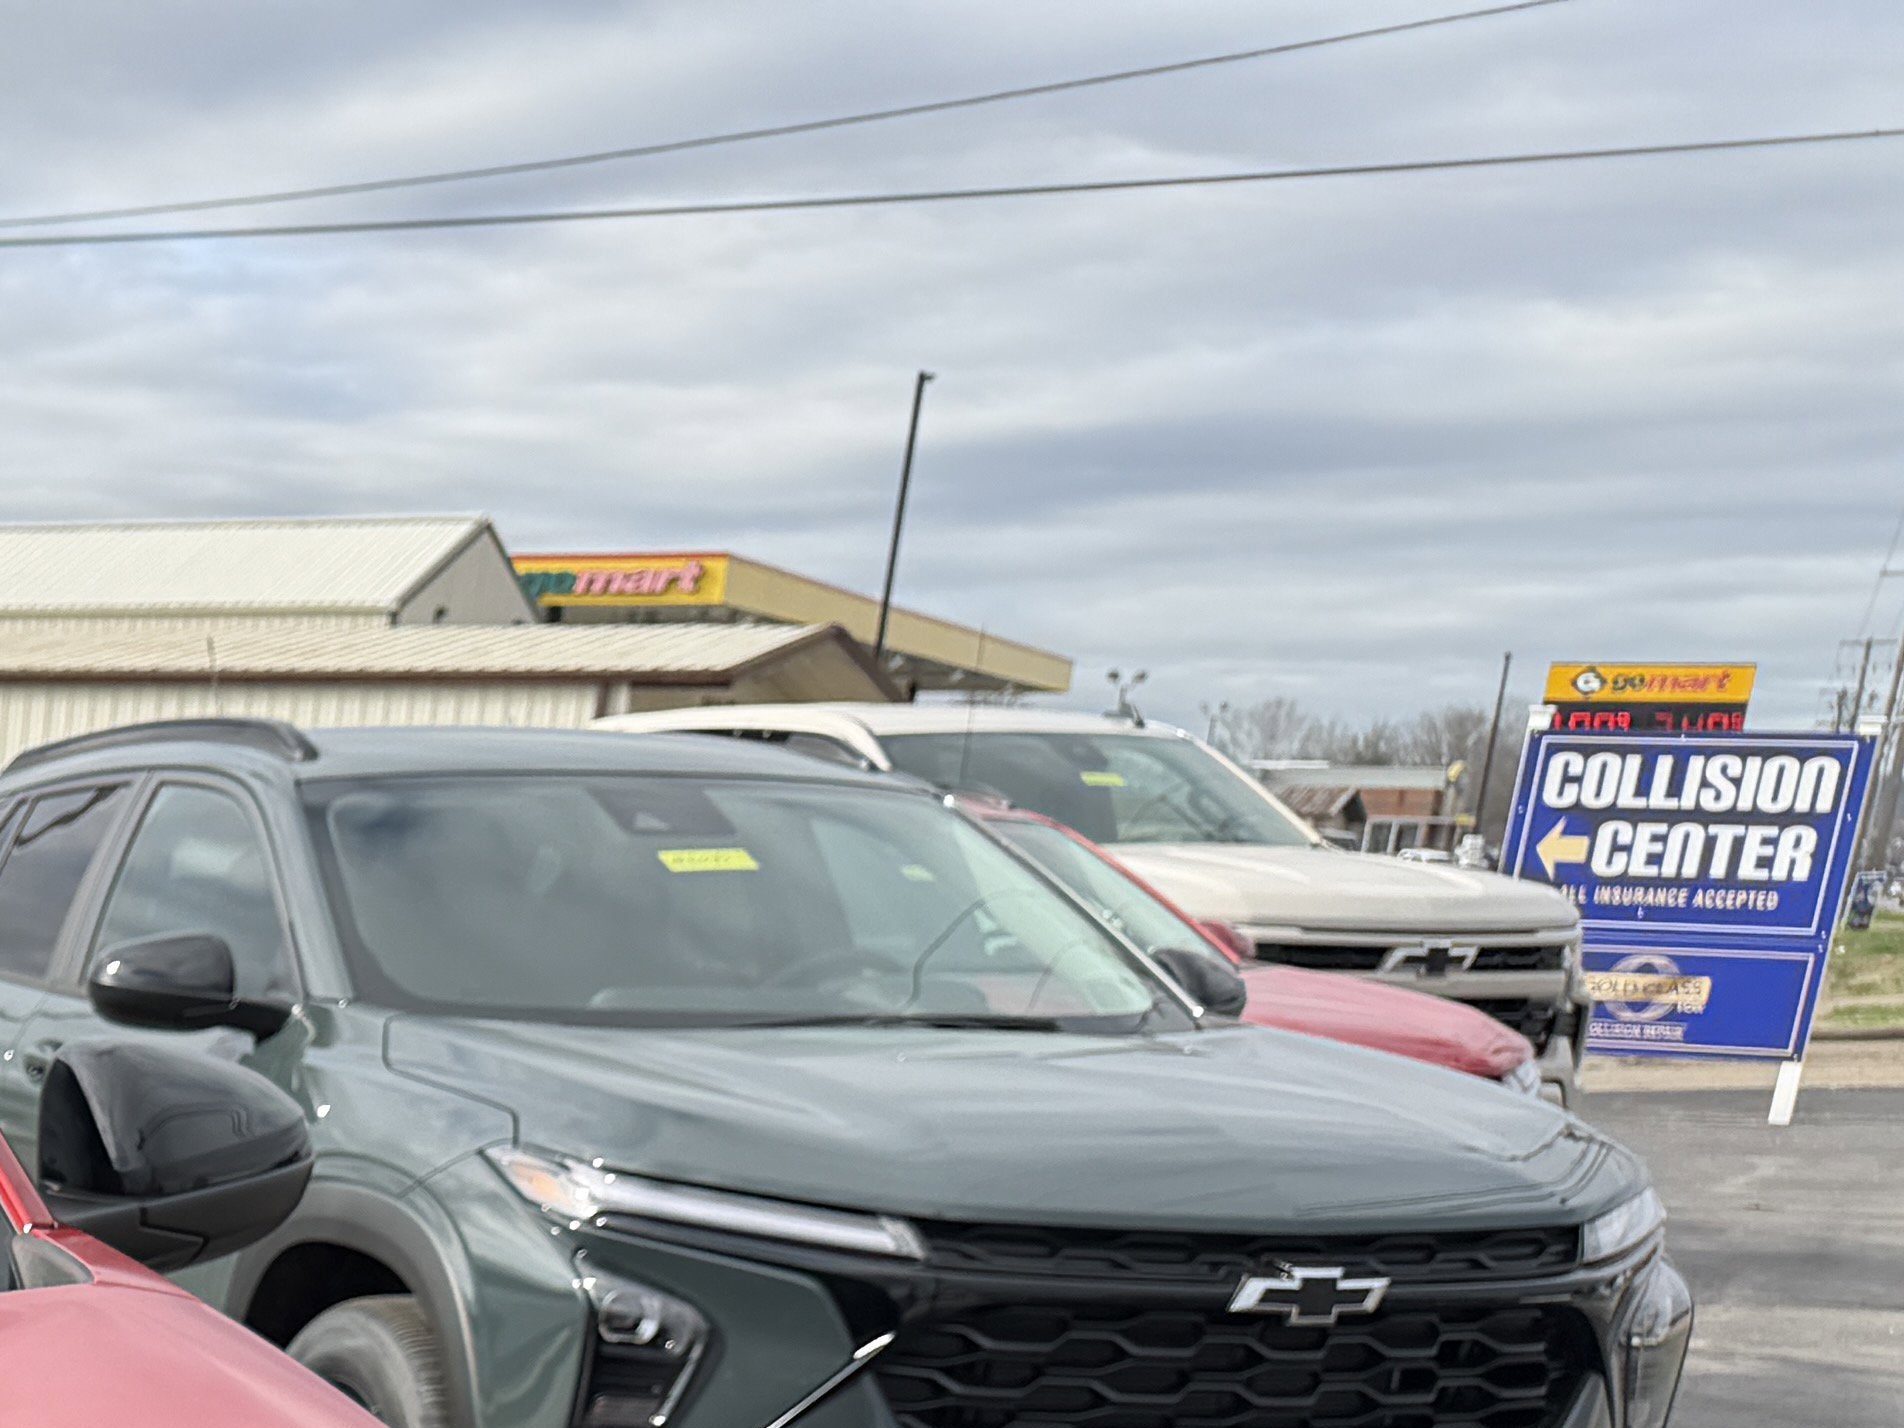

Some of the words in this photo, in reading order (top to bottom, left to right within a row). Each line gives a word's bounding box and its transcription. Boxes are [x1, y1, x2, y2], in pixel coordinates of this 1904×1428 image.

[1542, 751, 1841, 814] COLLISION
[1590, 820, 1818, 882] CENTER
[1594, 886, 1689, 908] INSURANCE
[1692, 888, 1780, 911] ACCEPTED
